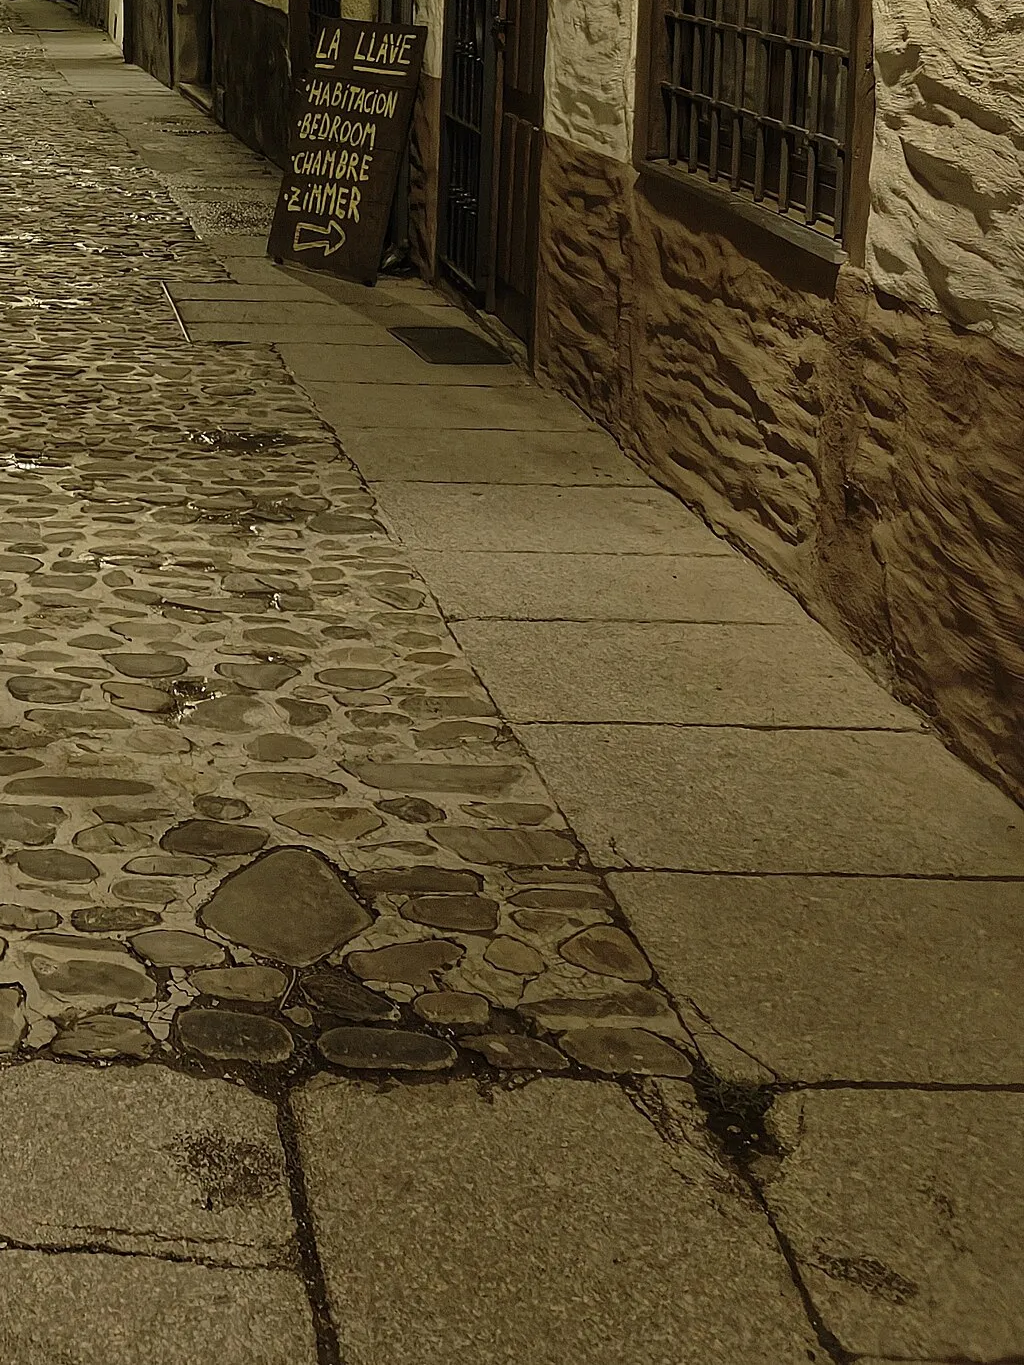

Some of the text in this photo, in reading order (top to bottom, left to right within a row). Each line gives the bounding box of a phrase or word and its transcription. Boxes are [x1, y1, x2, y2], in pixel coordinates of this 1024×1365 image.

[315, 27, 417, 65] LA LLAVE
[307, 79, 399, 119] HABITACION
[299, 112, 376, 150] BEDROOM
[293, 150, 373, 182] CHAMBRE
[286, 183, 362, 224] ZIMMER
